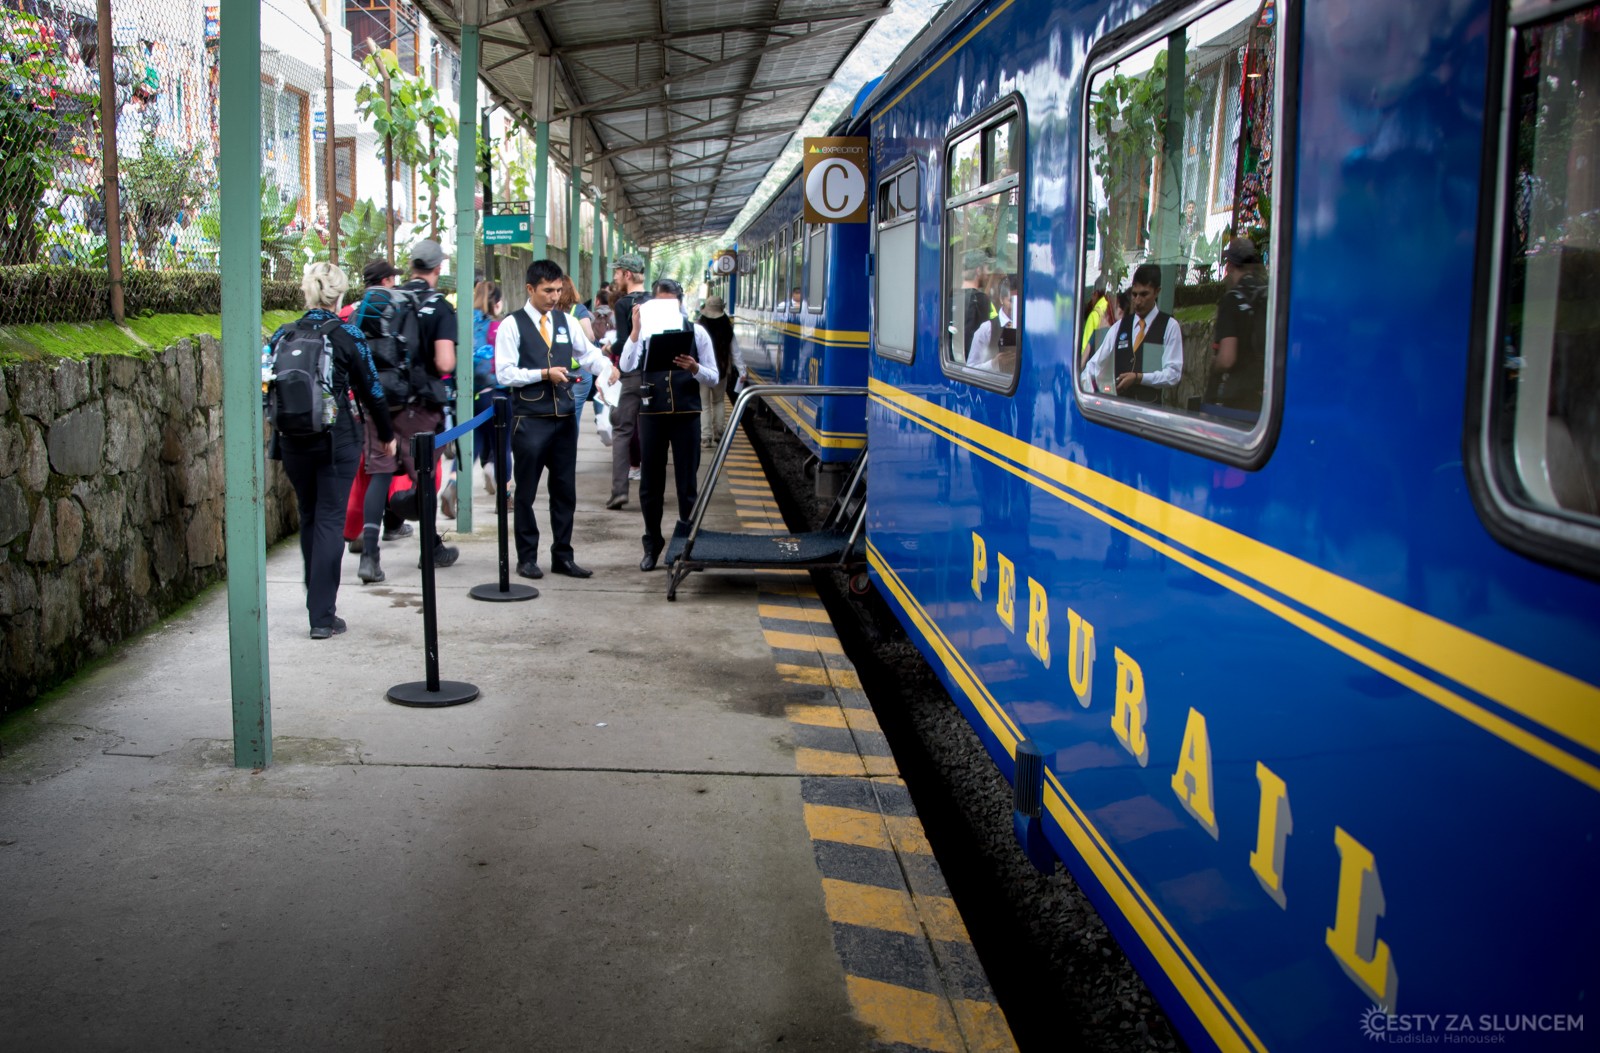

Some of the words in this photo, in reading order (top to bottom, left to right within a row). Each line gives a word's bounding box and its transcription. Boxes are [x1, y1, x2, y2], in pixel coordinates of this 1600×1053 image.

[822, 163, 849, 213] C
[722, 256, 730, 270] B
[971, 531, 1398, 1003] PERURAIL
